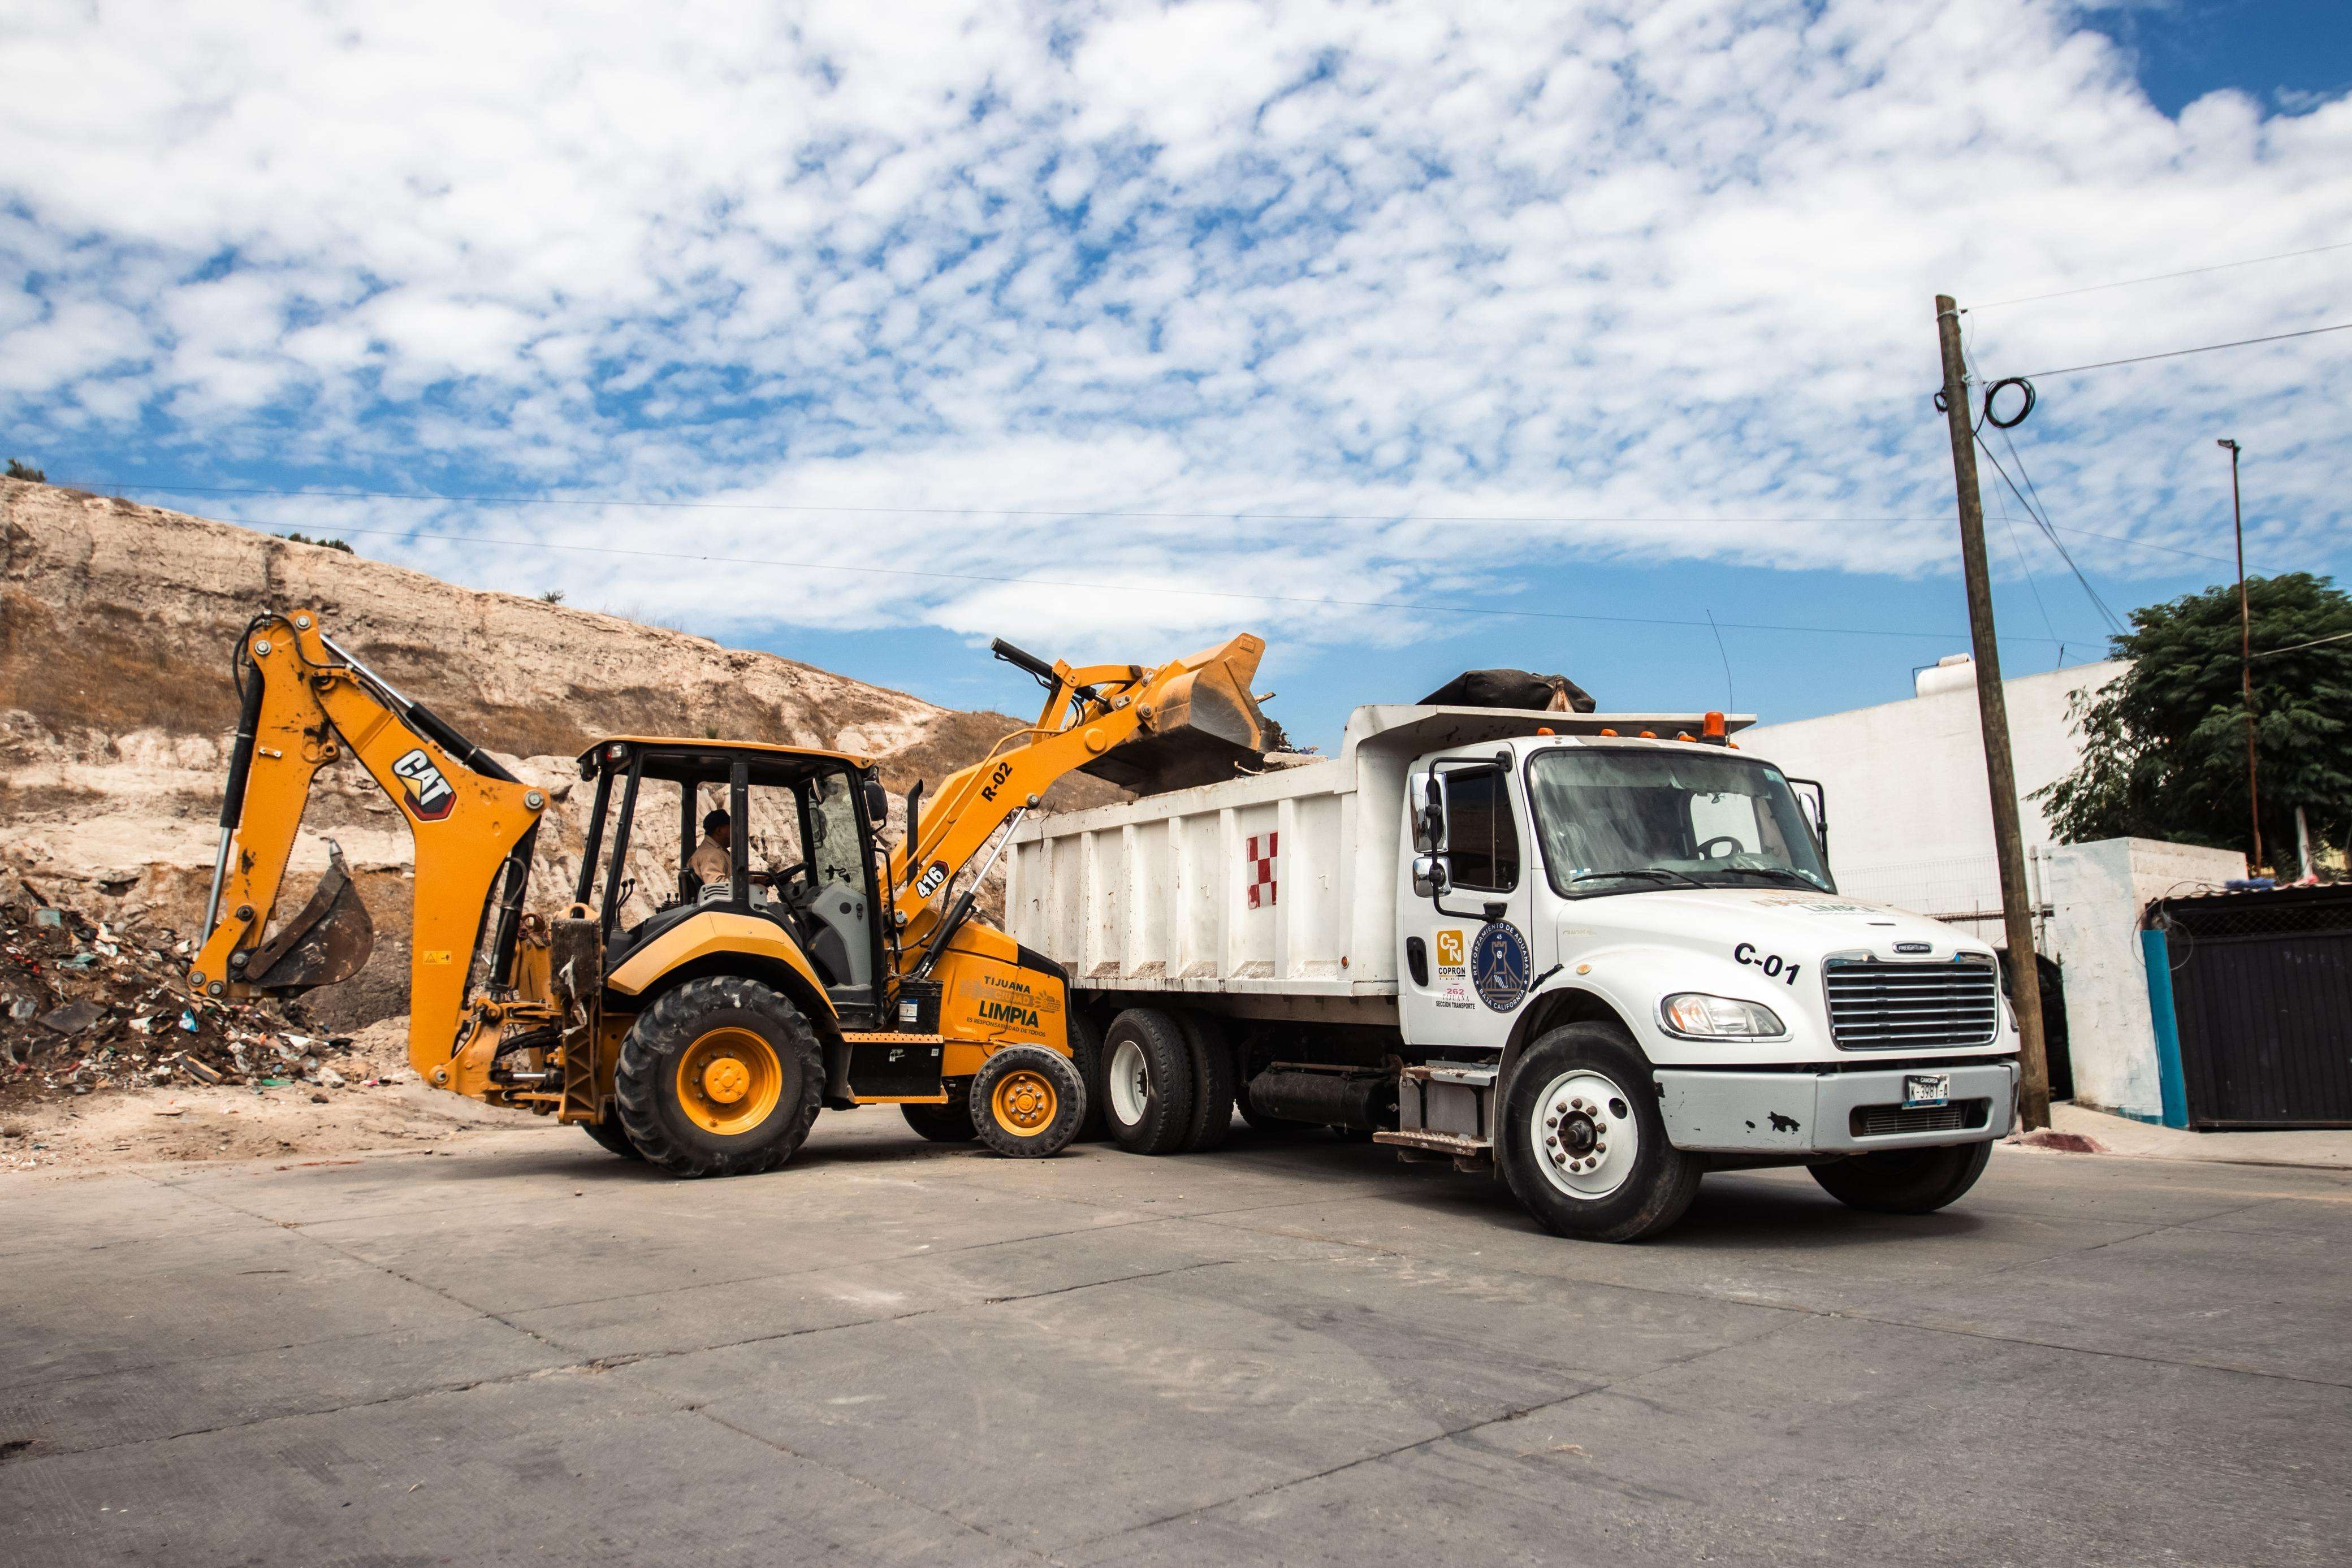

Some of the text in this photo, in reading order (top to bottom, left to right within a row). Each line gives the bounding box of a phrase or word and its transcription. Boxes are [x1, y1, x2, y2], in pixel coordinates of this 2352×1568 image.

[394, 750, 453, 806] CAT
[981, 762, 1013, 802] R-02
[916, 867, 944, 898] 416
[1473, 922, 1529, 976] REFORZAMIENTO DE ADUANAS
[1734, 942, 1801, 986] C-01
[984, 976, 1031, 994] TIJUANA
[1479, 988, 1525, 1010] BAJA CALIFORNIA
[979, 1000, 1039, 1028] LIMPIA
